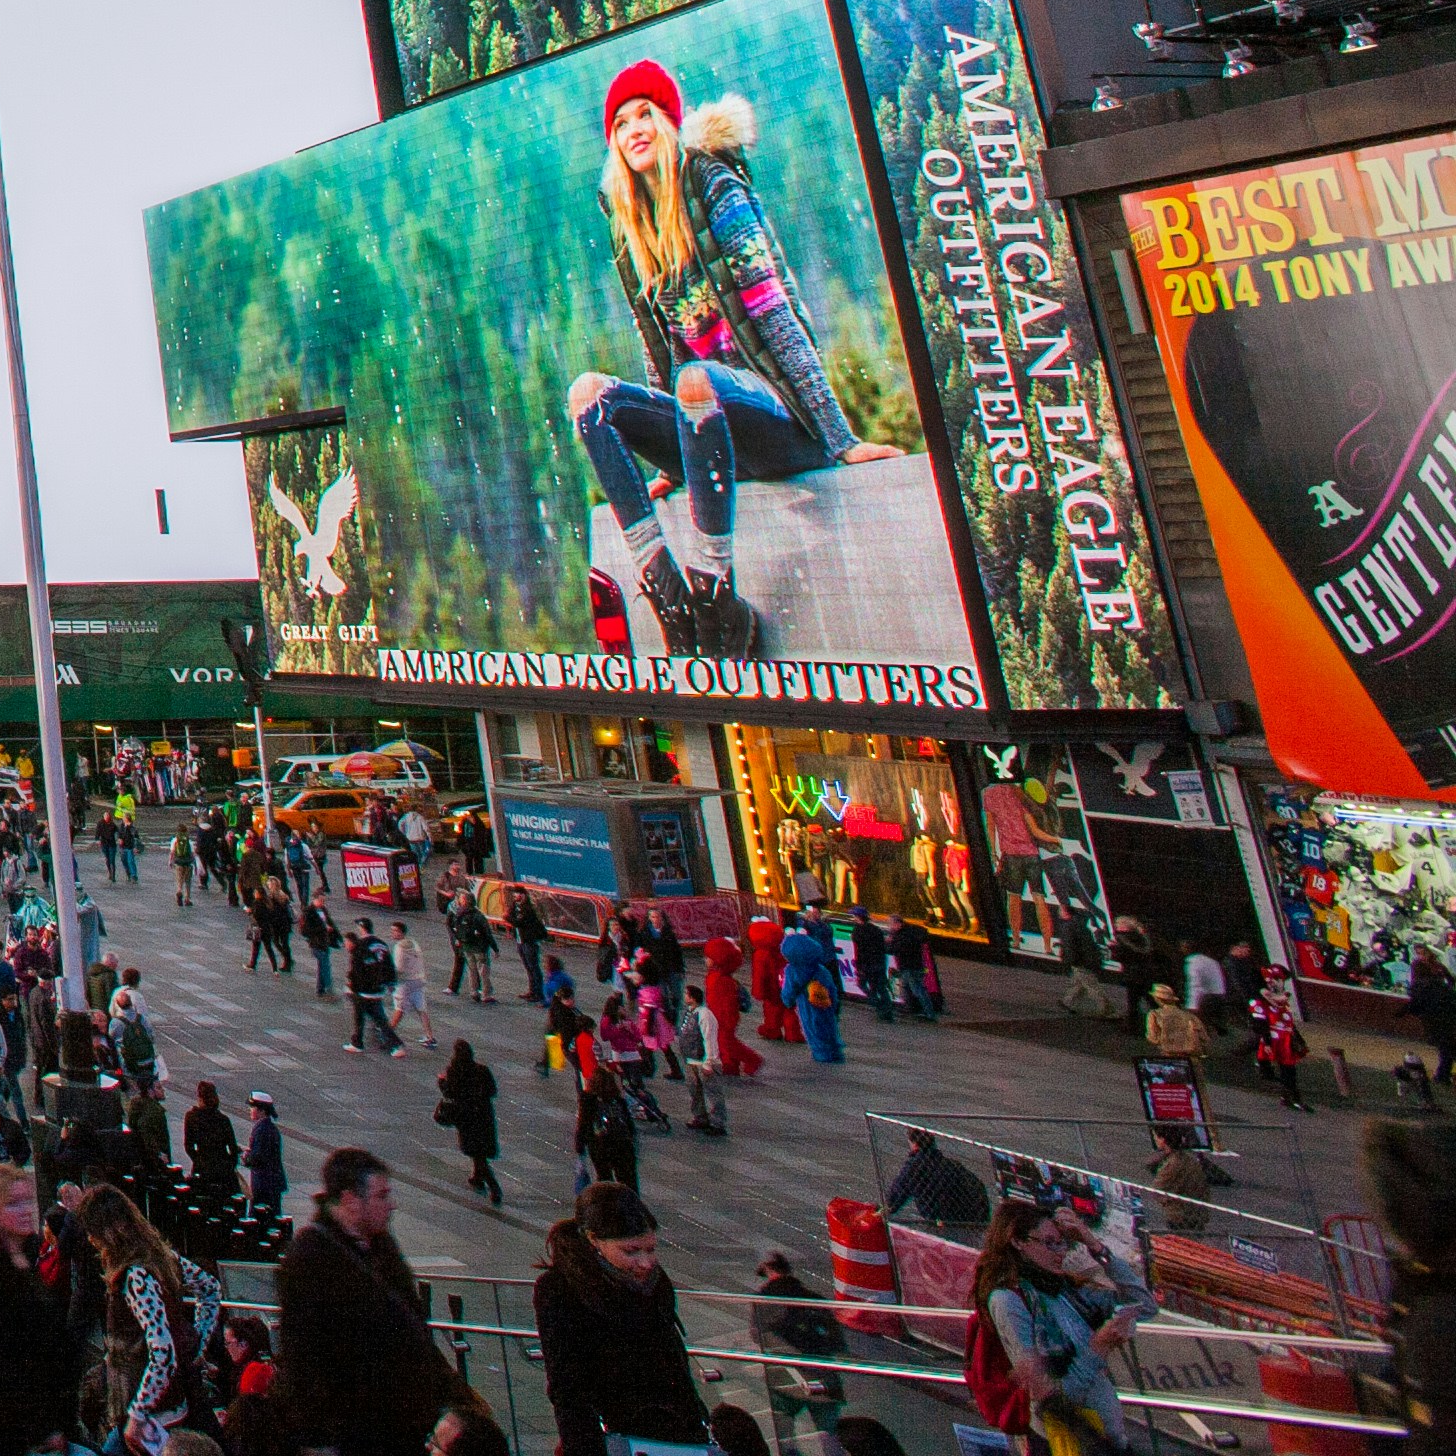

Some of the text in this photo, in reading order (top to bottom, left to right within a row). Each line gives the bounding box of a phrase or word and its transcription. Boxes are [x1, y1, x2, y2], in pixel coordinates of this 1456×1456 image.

[1142, 167, 1346, 273] BEST
[1164, 251, 1374, 316] 2014 TONY
[918, 149, 1042, 495] OUTFITTERS
[945, 26, 1143, 633] AMERICAN EAGLE
[1310, 479, 1362, 528] A
[281, 622, 378, 643] GREAT GIFT
[382, 648, 981, 709] AMERICAN EAGLE OUTFITTERS
[1302, 842, 1321, 859] 10
[1312, 876, 1327, 891] 18
